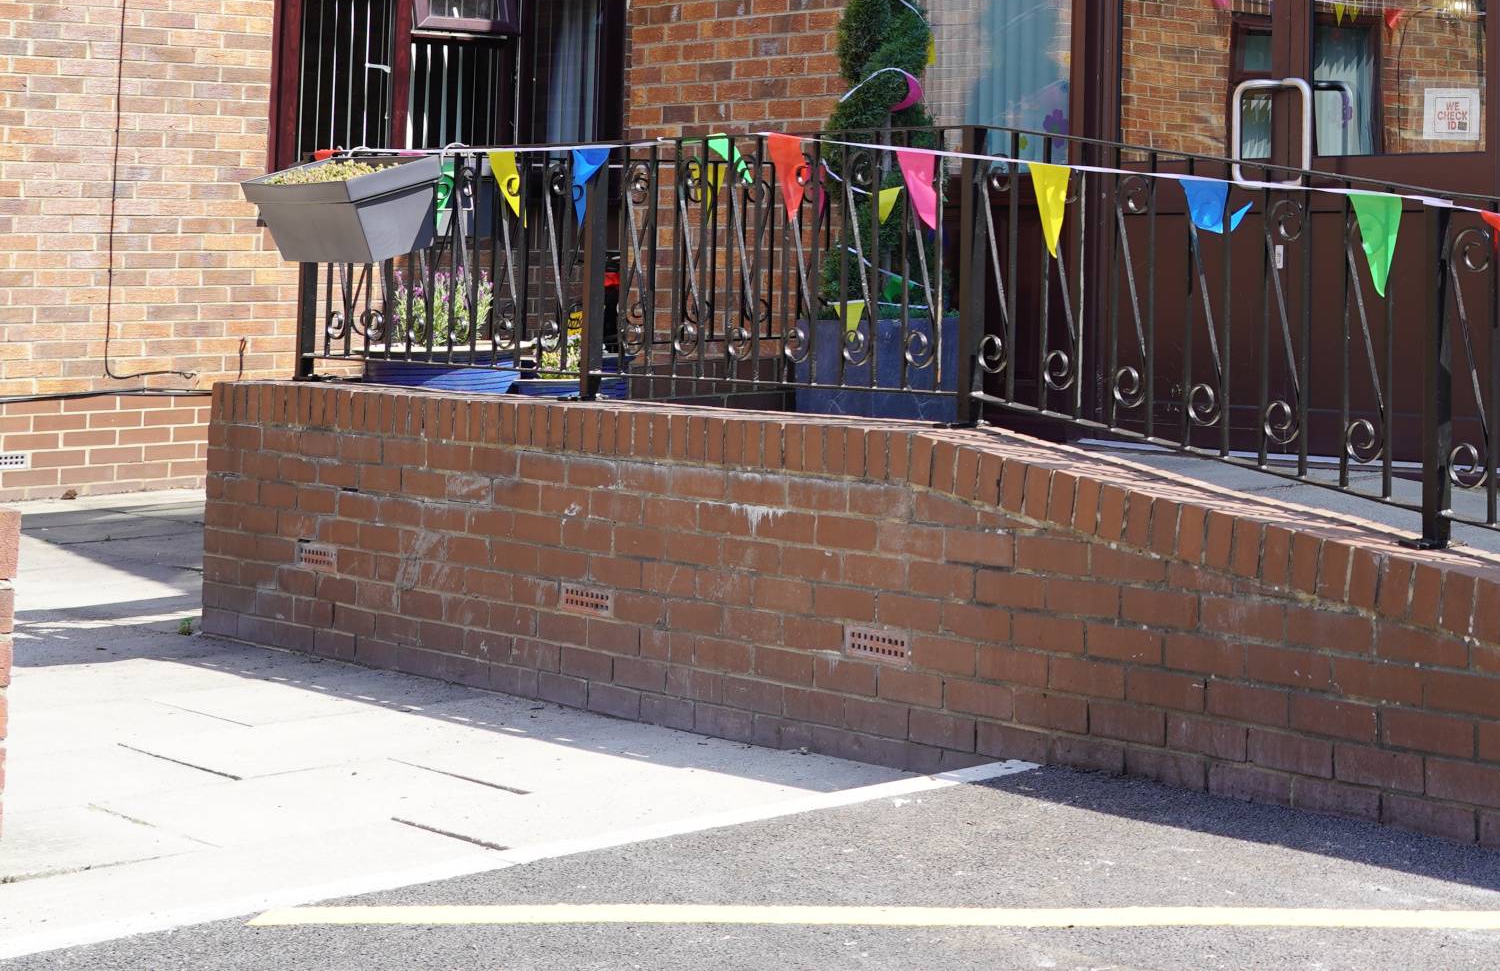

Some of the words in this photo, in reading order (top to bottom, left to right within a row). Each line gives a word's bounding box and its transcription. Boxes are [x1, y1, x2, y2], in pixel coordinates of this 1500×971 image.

[1446, 101, 1460, 111] WE
[1437, 111, 1468, 121] CHECK
[1447, 121, 1457, 131] ID
